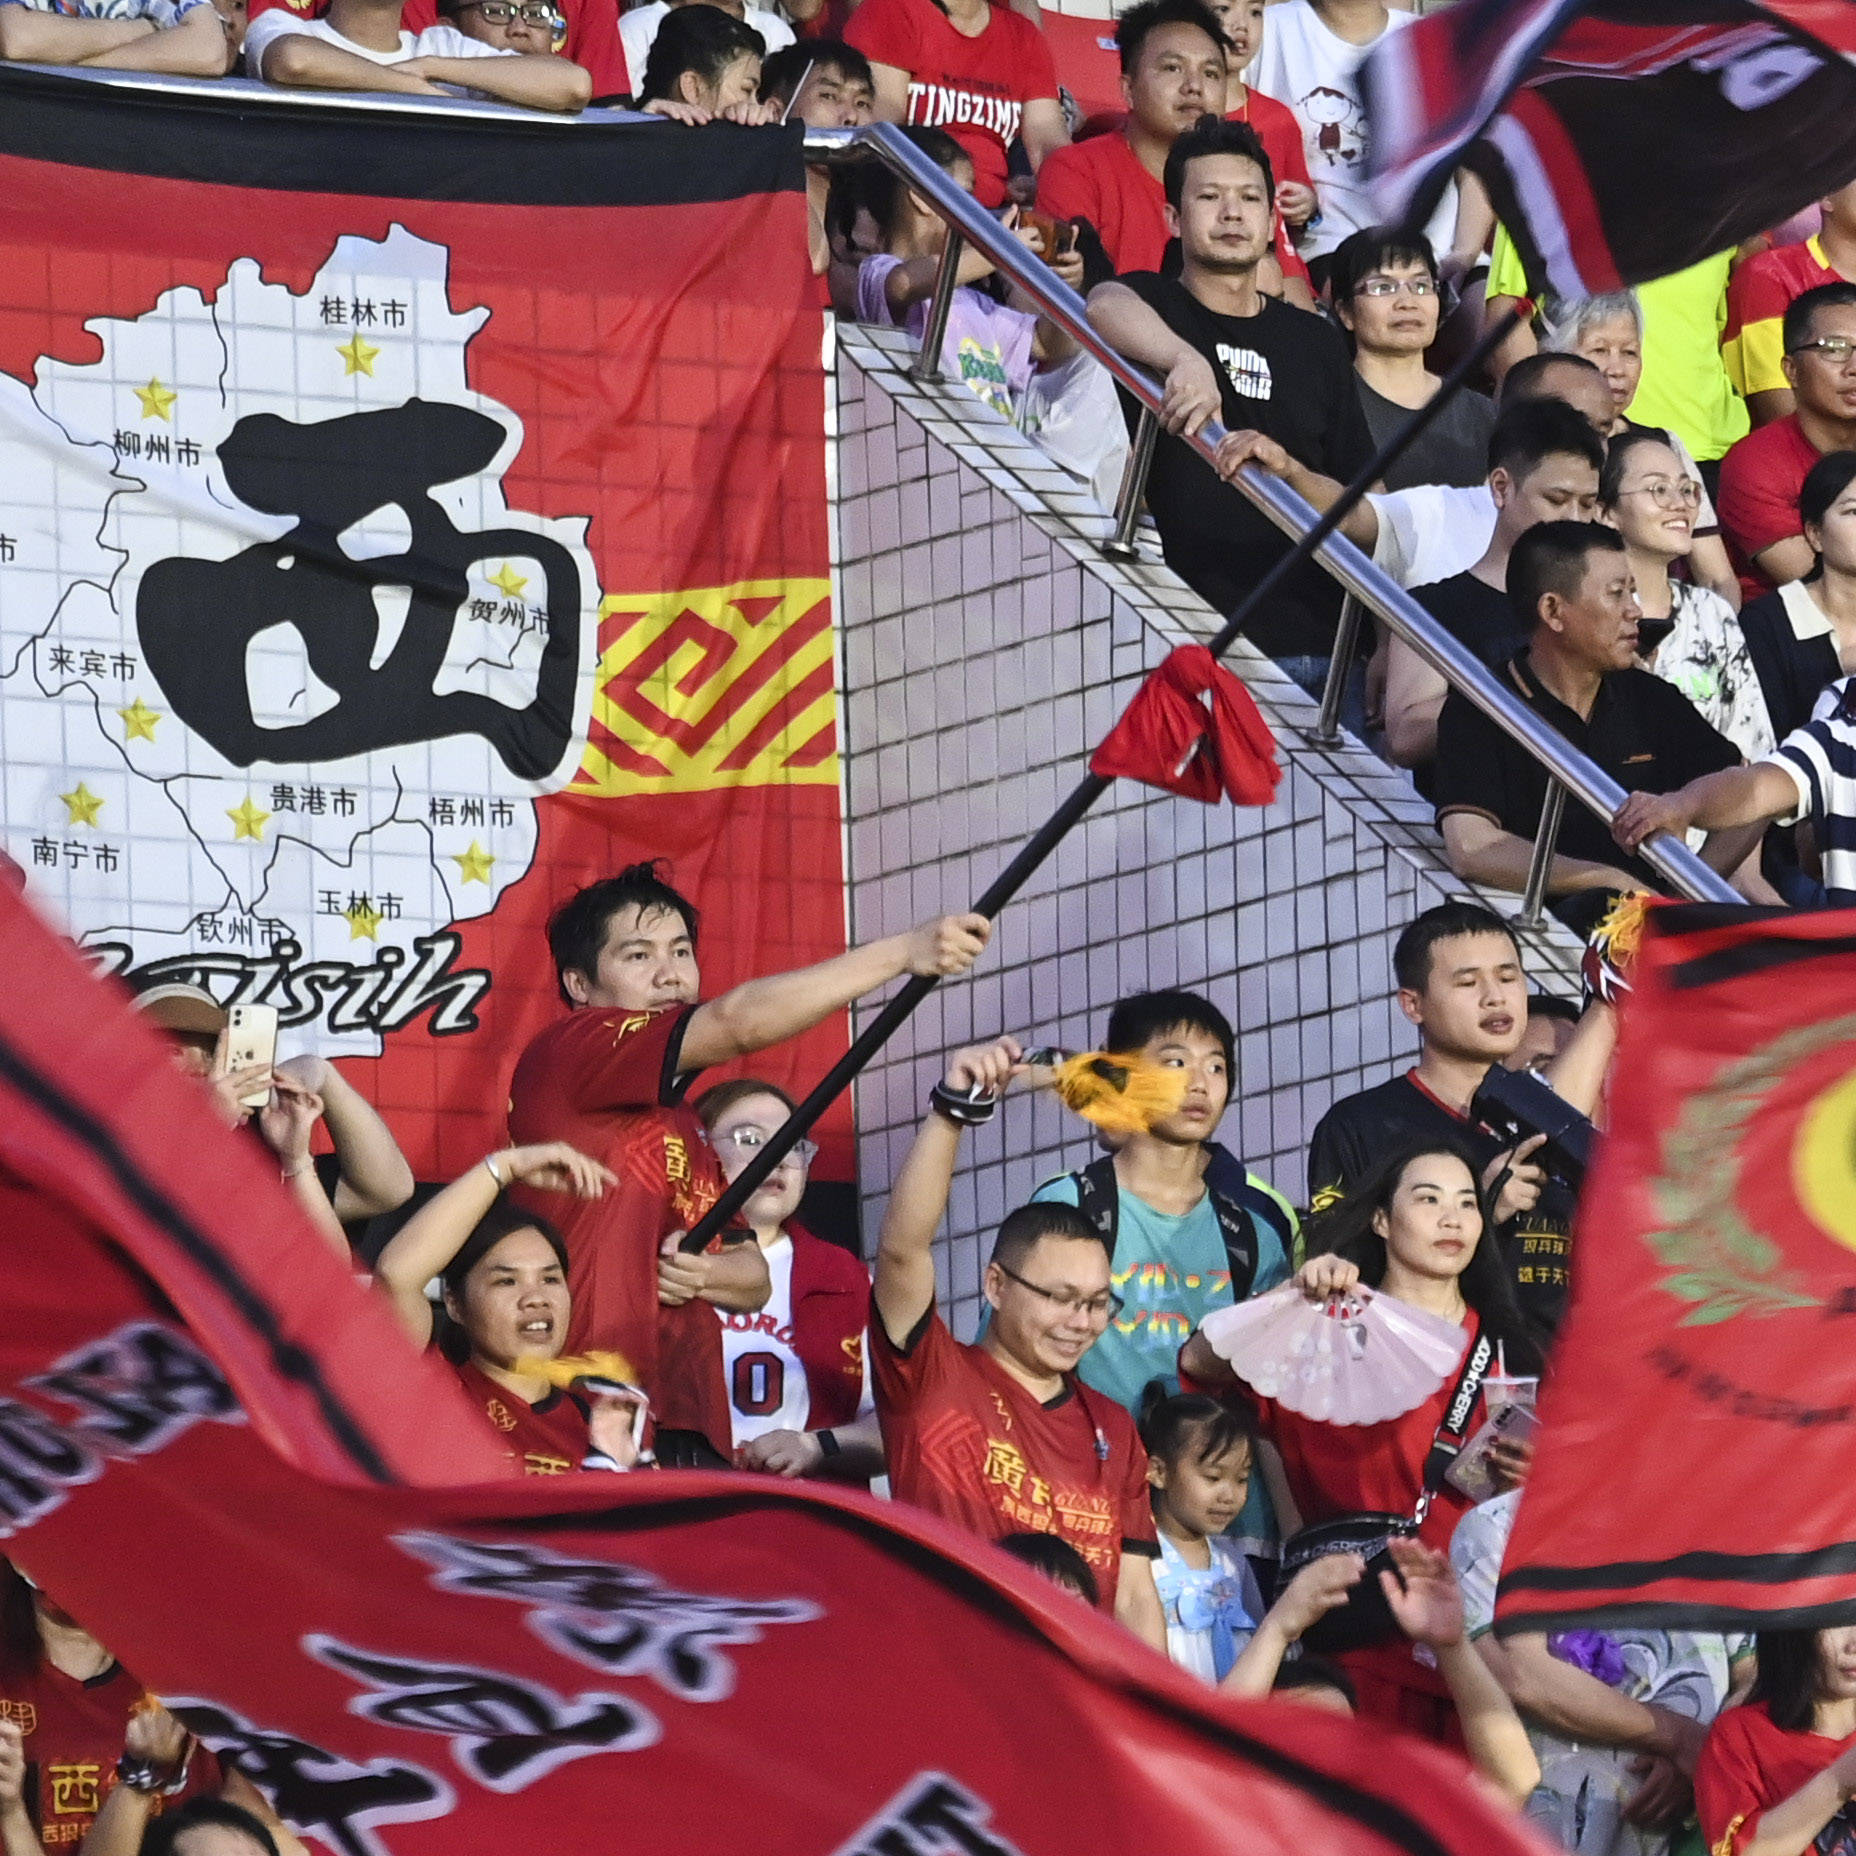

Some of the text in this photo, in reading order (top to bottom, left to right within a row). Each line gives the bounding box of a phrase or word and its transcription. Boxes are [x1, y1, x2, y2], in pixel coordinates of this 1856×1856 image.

[320, 296, 408, 329] 桂林市
[114, 431, 202, 468] 柳州市
[469, 598, 551, 636] 贺州市
[48, 646, 137, 683] 来宾市
[270, 783, 357, 818] 贵港市
[428, 797, 515, 831] 梧州市
[31, 838, 119, 875] 南宁市
[318, 890, 403, 922] 玉林市
[196, 916, 284, 947] 钦州市
[733, 1352, 785, 1417] 0
